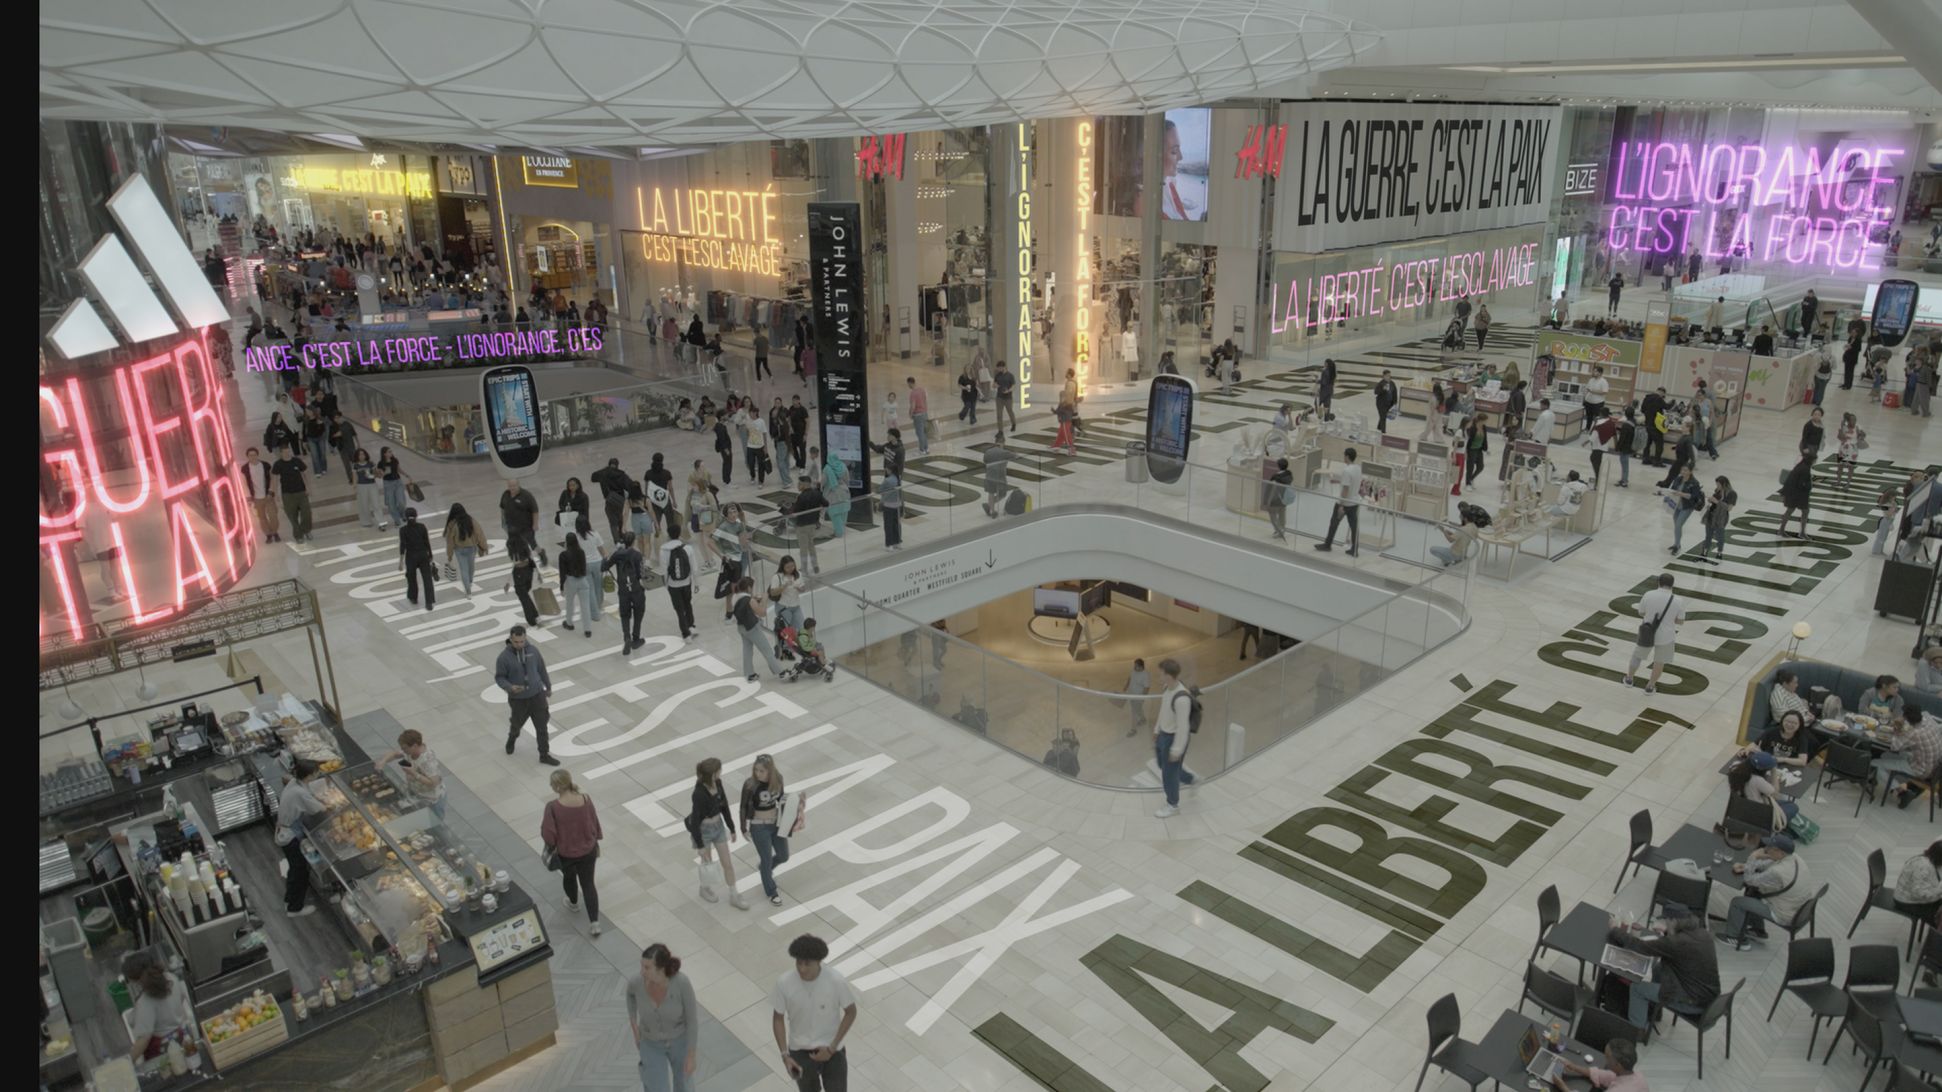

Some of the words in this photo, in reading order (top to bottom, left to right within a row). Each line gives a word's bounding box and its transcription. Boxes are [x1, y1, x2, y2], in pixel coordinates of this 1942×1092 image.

[855, 132, 906, 181] H&M
[1077, 121, 1092, 230] C'EST
[1235, 123, 1288, 180] H&M
[1298, 120, 1330, 226] LA
[1336, 119, 1424, 227] GUERRE,
[1426, 118, 1484, 215] C'EST
[1478, 119, 1507, 209] LA
[1505, 119, 1551, 207] PAIX
[1565, 169, 1597, 190] BIZE
[1613, 141, 1905, 215] L'IGNORANCE
[637, 186, 669, 233] LA
[675, 183, 779, 243] LIBERTÉ
[1608, 204, 1701, 255] C'EST
[1705, 209, 1751, 260] LA
[1763, 213, 1890, 270] FORCE
[642, 233, 678, 263] C'EST
[683, 237, 781, 277] L'ESCLAVAGE
[830, 216, 847, 277] JOHN
[1018, 123, 1031, 410] L'IGNORANCE
[1078, 233, 1090, 280] LA
[823, 267, 832, 317] PARTNERS
[1271, 279, 1300, 334] LA
[1306, 257, 1384, 327] LIBERTÉ,
[1390, 258, 1439, 312] C'EST
[1440, 243, 1538, 301] L'ESCLAVAGE
[246, 345, 301, 373] ANCE,
[303, 340, 353, 369] C'EST
[357, 337, 384, 366] LA
[385, 335, 442, 364] FORCE
[457, 328, 565, 360] L'IGNORANCE,
[567, 326, 604, 352] C'ES
[835, 289, 850, 358] LEWIS
[1076, 283, 1091, 397] FORCE
[110, 500, 219, 626] LA
[893, 587, 920, 602] QUARTER
[927, 574, 958, 590] WESTFIELD
[961, 566, 982, 579] SQUARE
[904, 568, 927, 581] JOHN
[930, 559, 956, 574] LEWIS
[622, 723, 899, 868] LA
[1176, 672, 1698, 995] LIBERTÉ,
[1536, 574, 1790, 697] C'EST
[734, 785, 1134, 1037] PAIX
